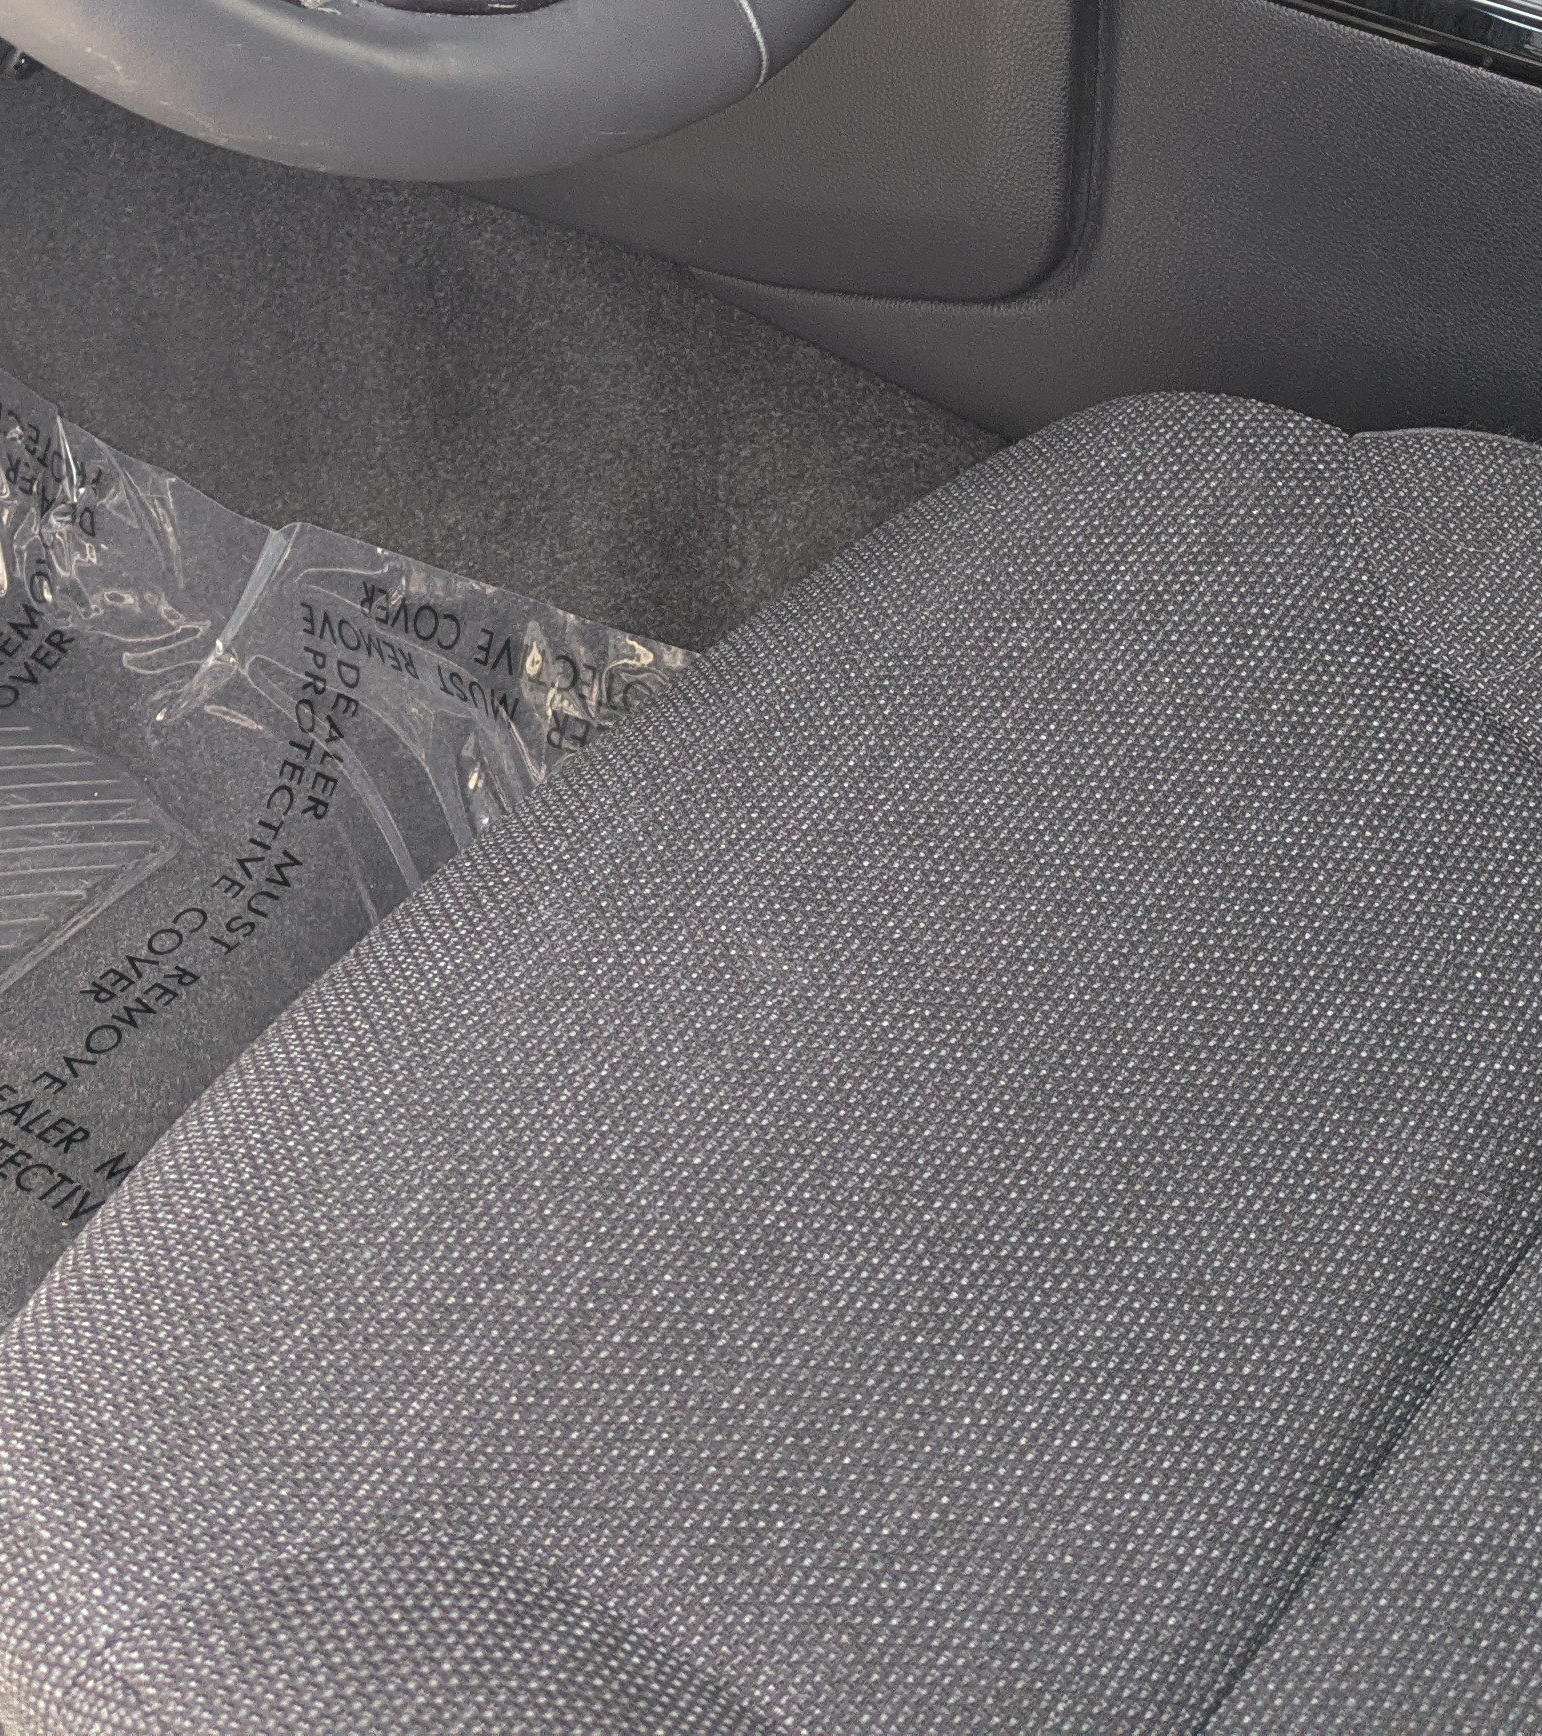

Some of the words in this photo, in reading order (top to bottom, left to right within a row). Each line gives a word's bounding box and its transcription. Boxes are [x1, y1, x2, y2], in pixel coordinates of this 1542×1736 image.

[300, 601, 419, 680] REMOVE
[360, 580, 461, 650] COVER
[302, 658, 361, 822] DEALER
[437, 664, 520, 720] MUST
[212, 645, 327, 900] PROTECTIVE
[211, 849, 304, 956] MUST
[79, 907, 208, 1005] COVER
[31, 964, 201, 1096] REMOVE
